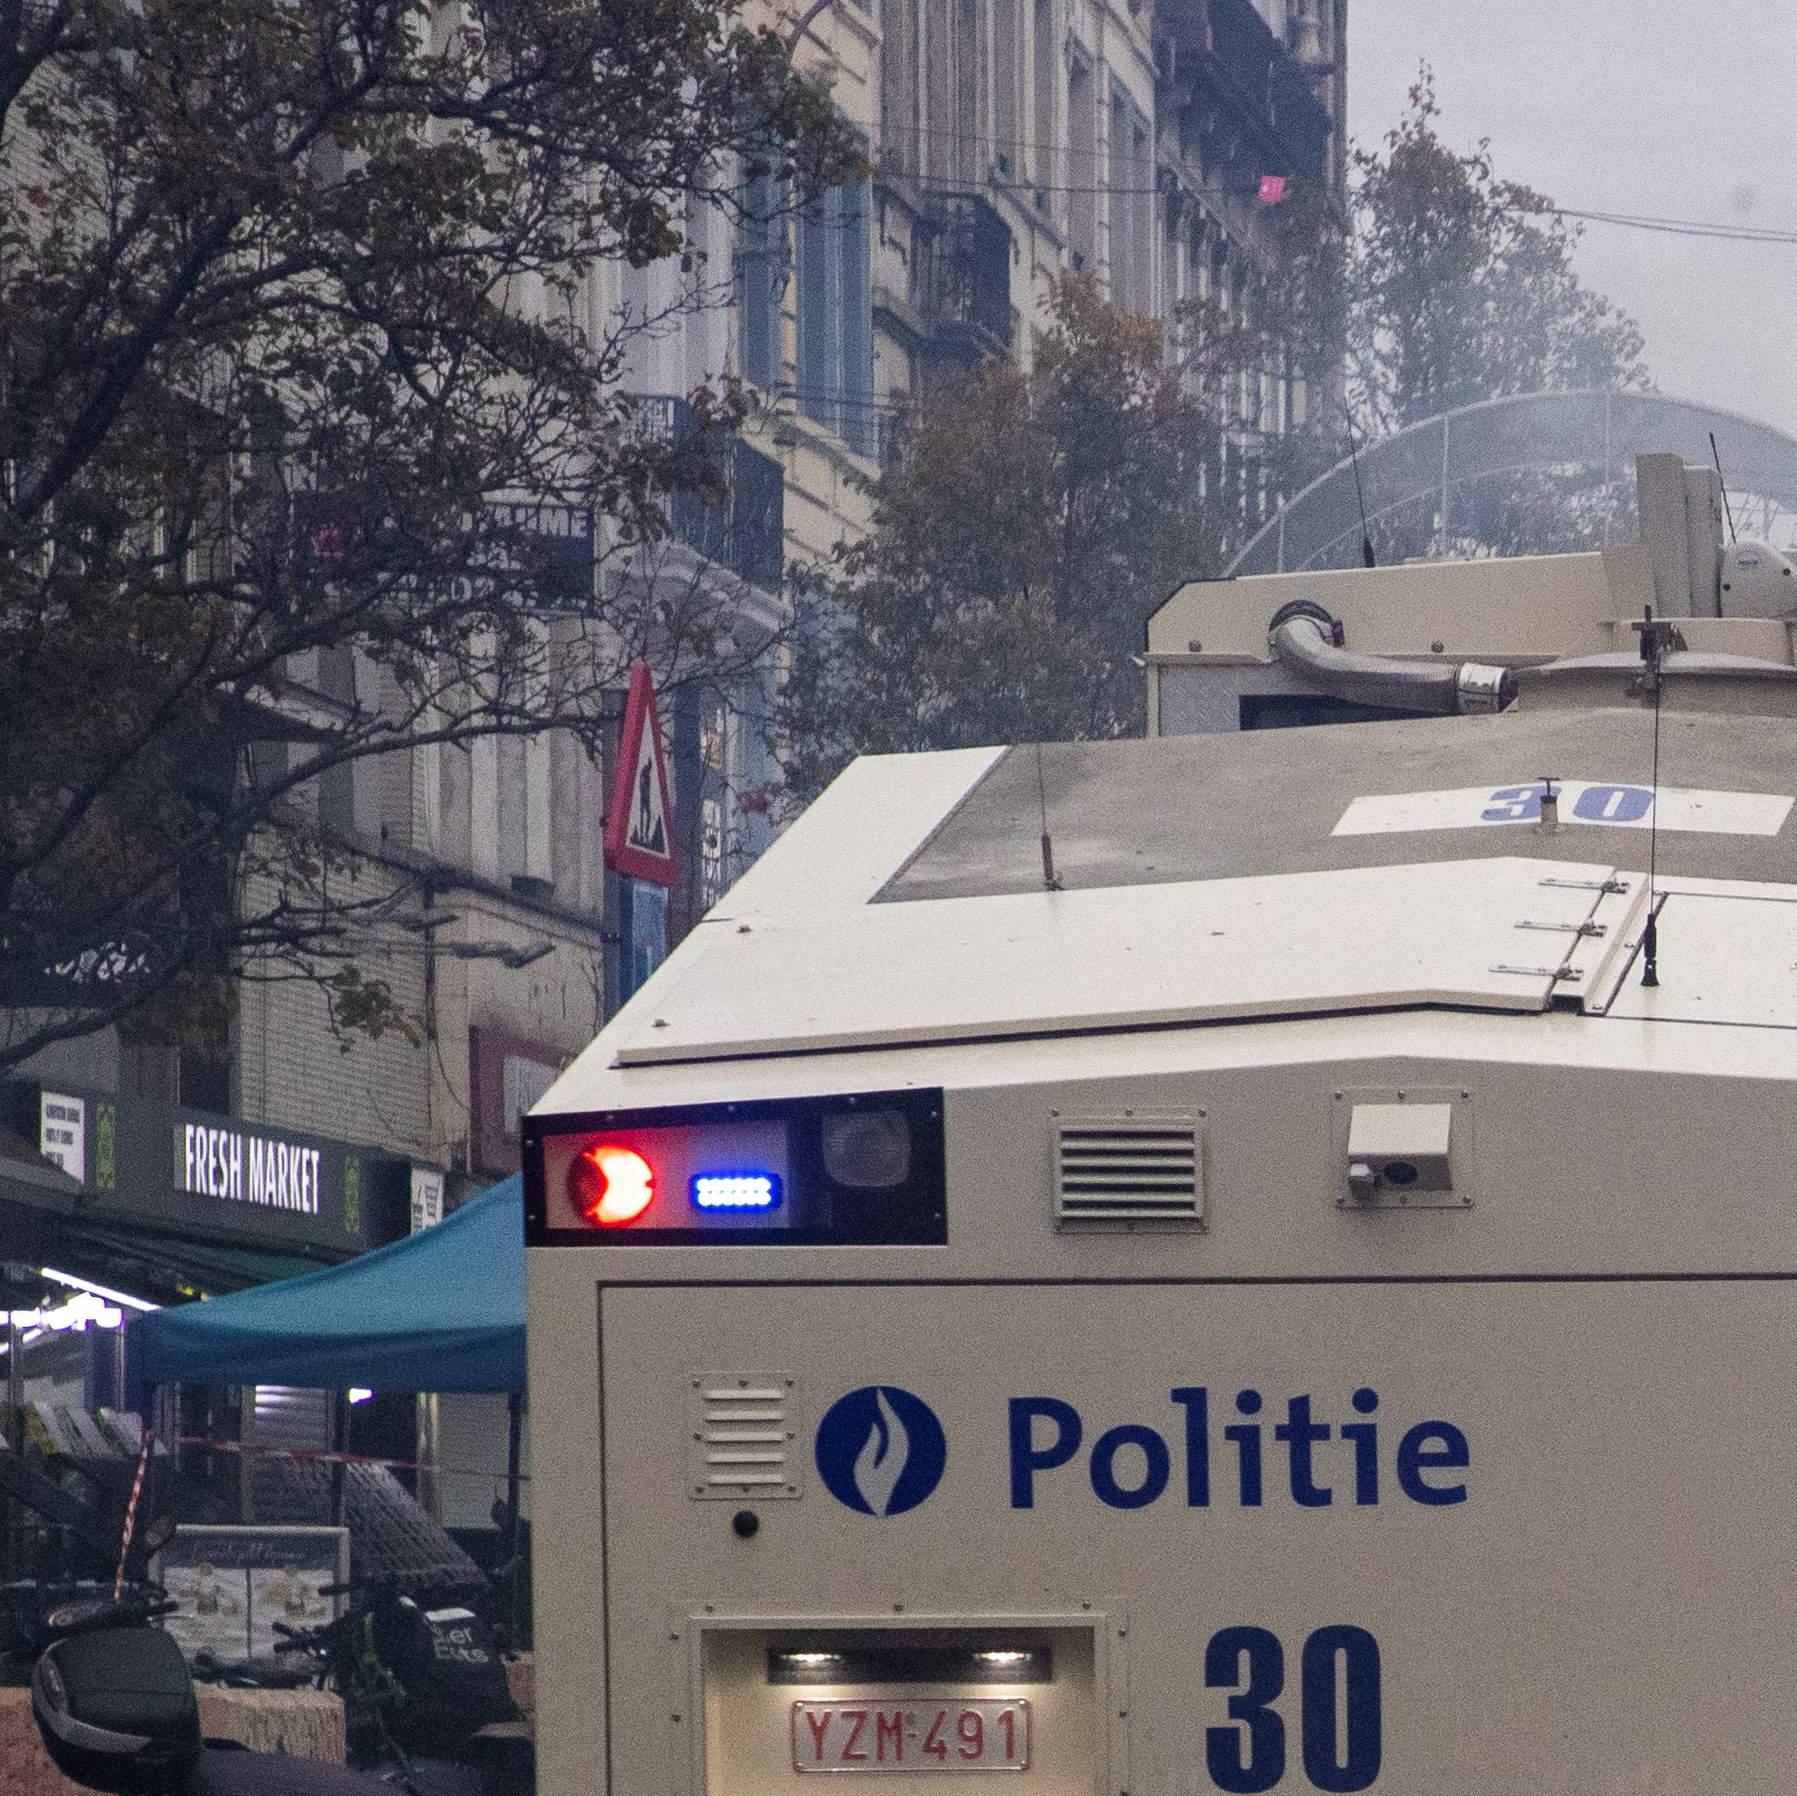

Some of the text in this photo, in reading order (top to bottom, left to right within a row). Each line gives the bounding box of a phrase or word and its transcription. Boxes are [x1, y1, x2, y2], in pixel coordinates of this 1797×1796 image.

[1481, 786, 1654, 822] 30
[185, 1124, 320, 1215] FRESH MARKET
[1009, 1386, 1471, 1510] Politie
[804, 1710, 1016, 1762] YZM-491
[1204, 1624, 1383, 1795] 30
